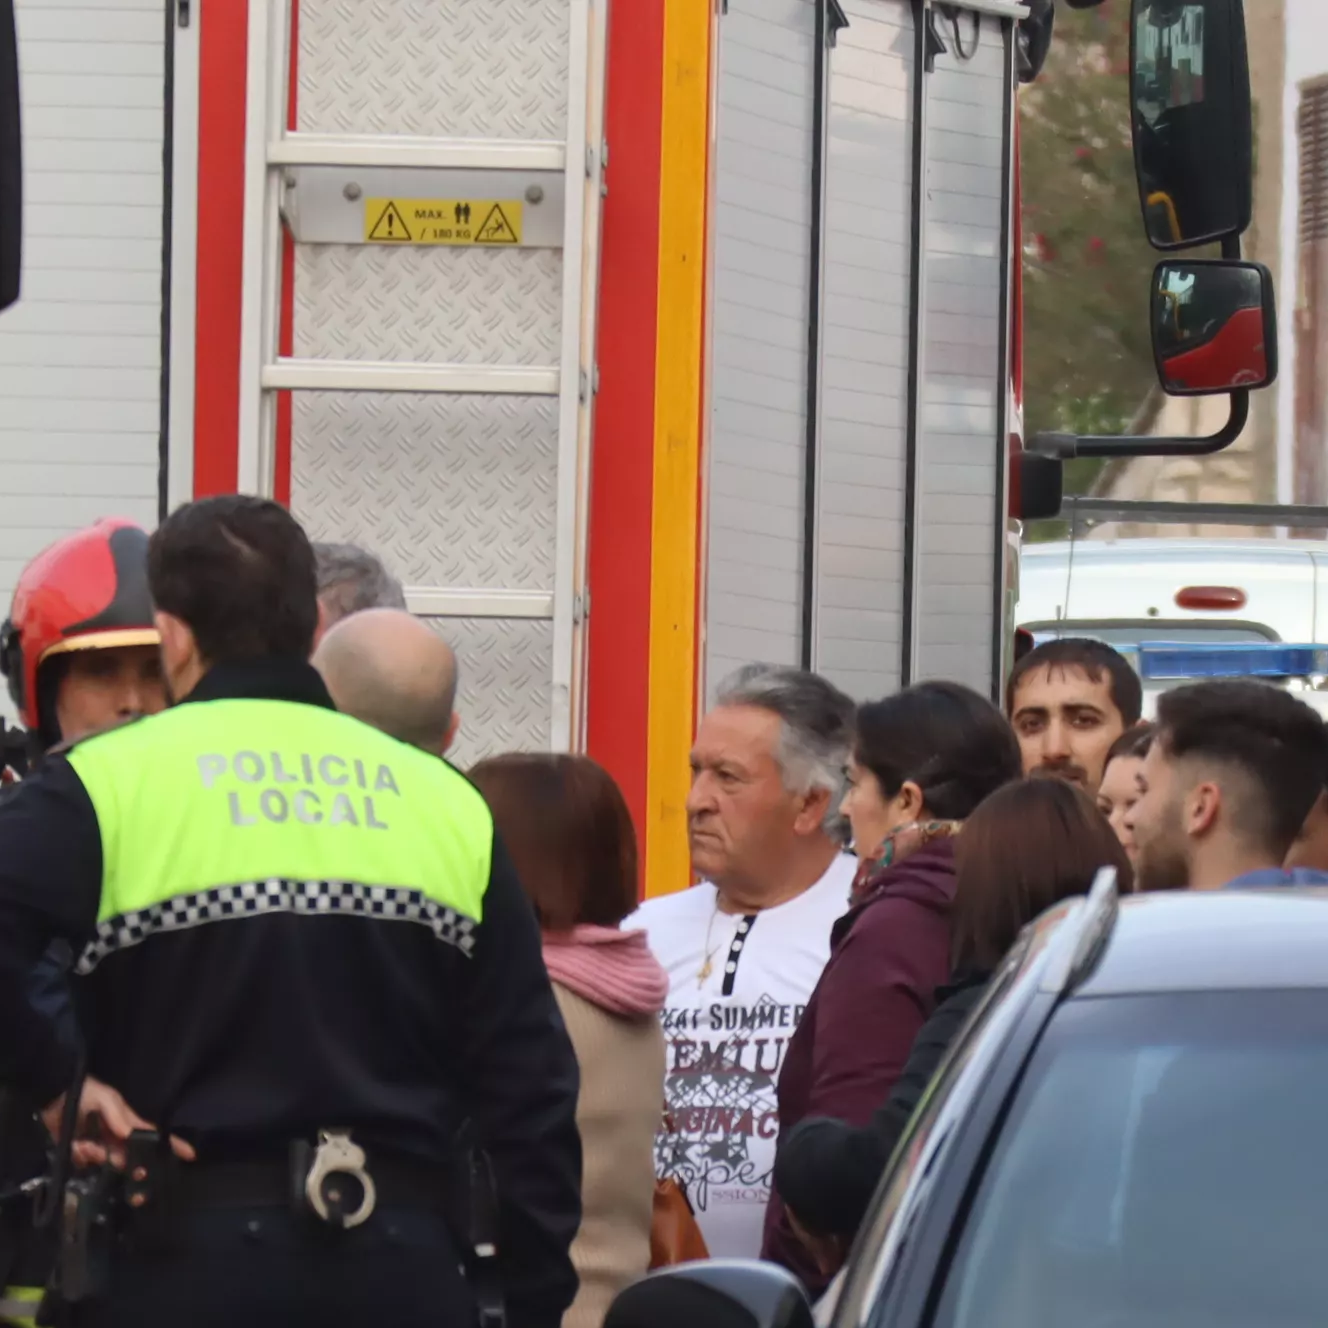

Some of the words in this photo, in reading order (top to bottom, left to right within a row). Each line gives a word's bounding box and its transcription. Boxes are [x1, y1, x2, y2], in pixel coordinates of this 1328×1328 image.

[196, 750, 401, 797] POLICIA
[228, 789, 389, 830] LOCAL
[670, 1037, 792, 1076] EMIU
